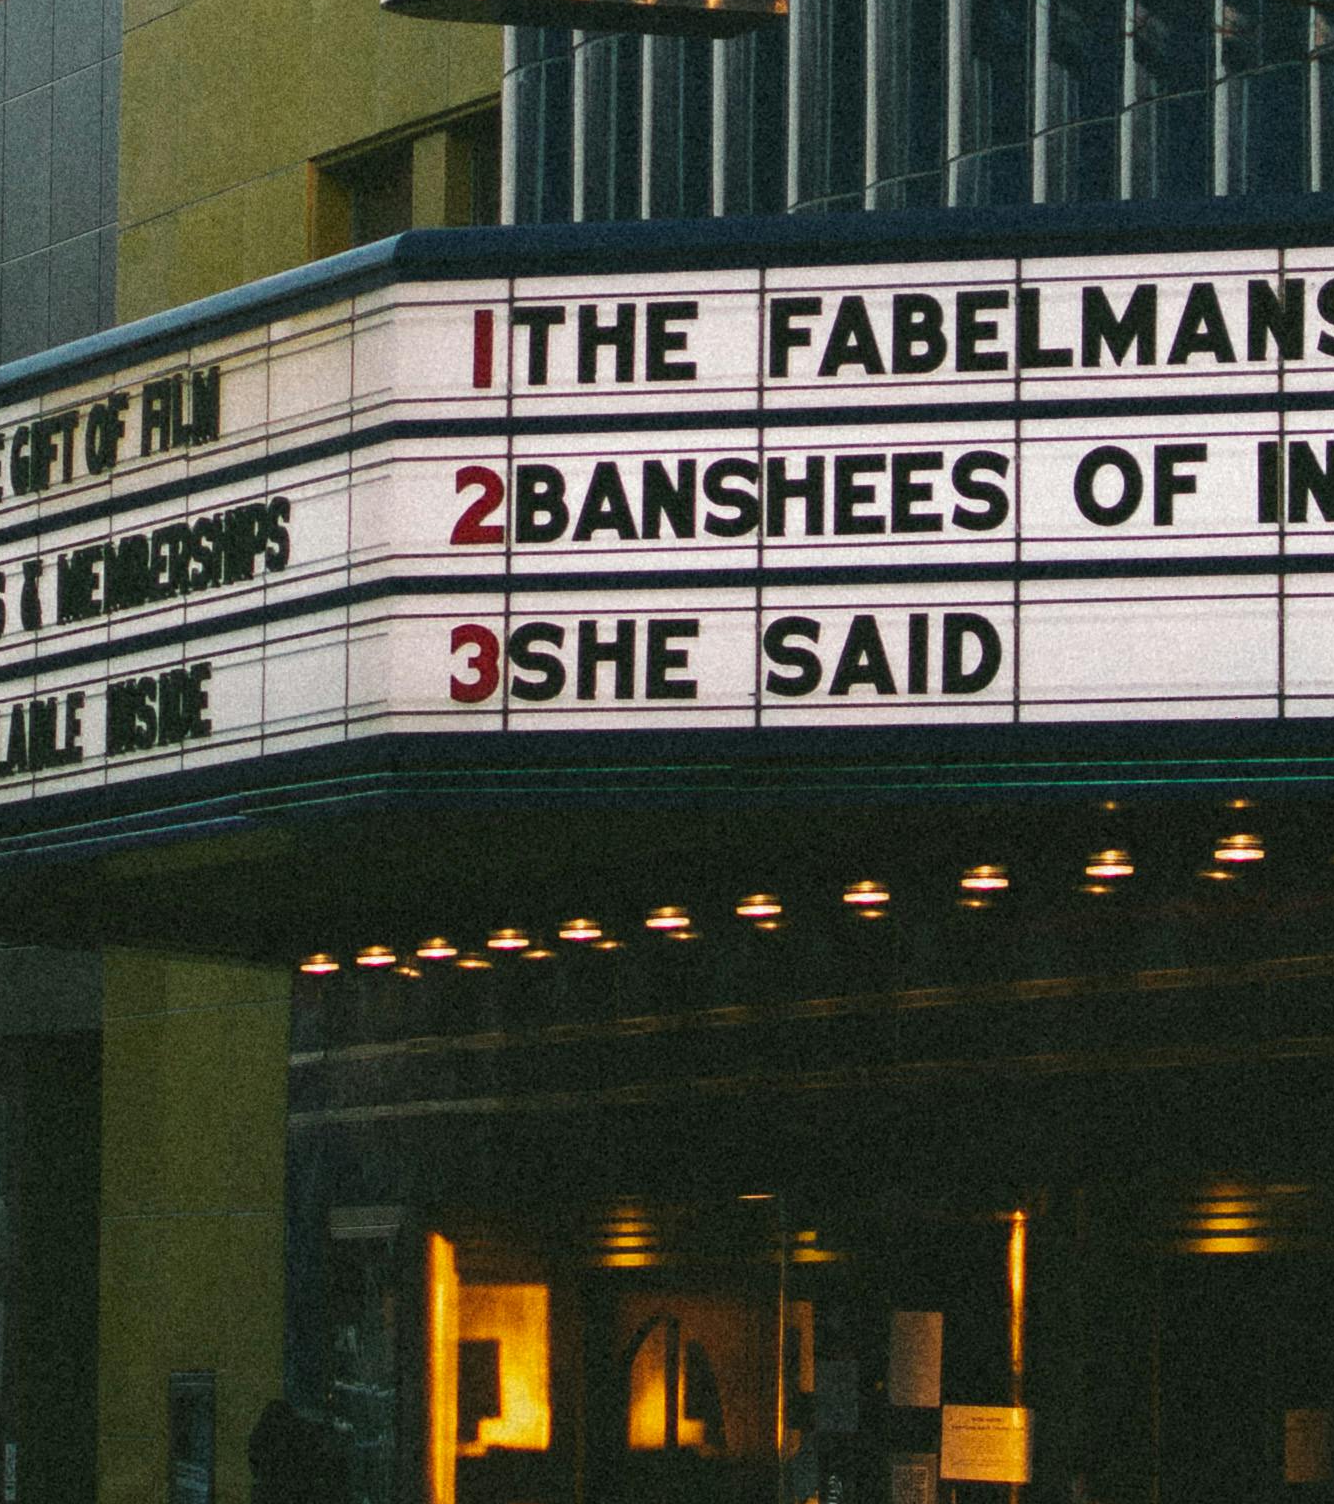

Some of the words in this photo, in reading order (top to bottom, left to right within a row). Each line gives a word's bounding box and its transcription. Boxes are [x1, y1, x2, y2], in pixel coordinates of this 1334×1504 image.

[511, 300, 699, 385] THE
[10, 410, 78, 498] GIFT
[85, 392, 127, 476] OF
[140, 365, 222, 458] FILM
[450, 464, 505, 546] 2
[513, 448, 1011, 545] BANSHEES
[1072, 443, 1208, 530] OF
[20, 559, 44, 632] &
[56, 495, 292, 627] MEMBERSHIPS
[448, 623, 500, 705] 3
[508, 617, 700, 701] SHE
[762, 611, 1004, 698] SAID
[104, 661, 214, 758] INSIDE
